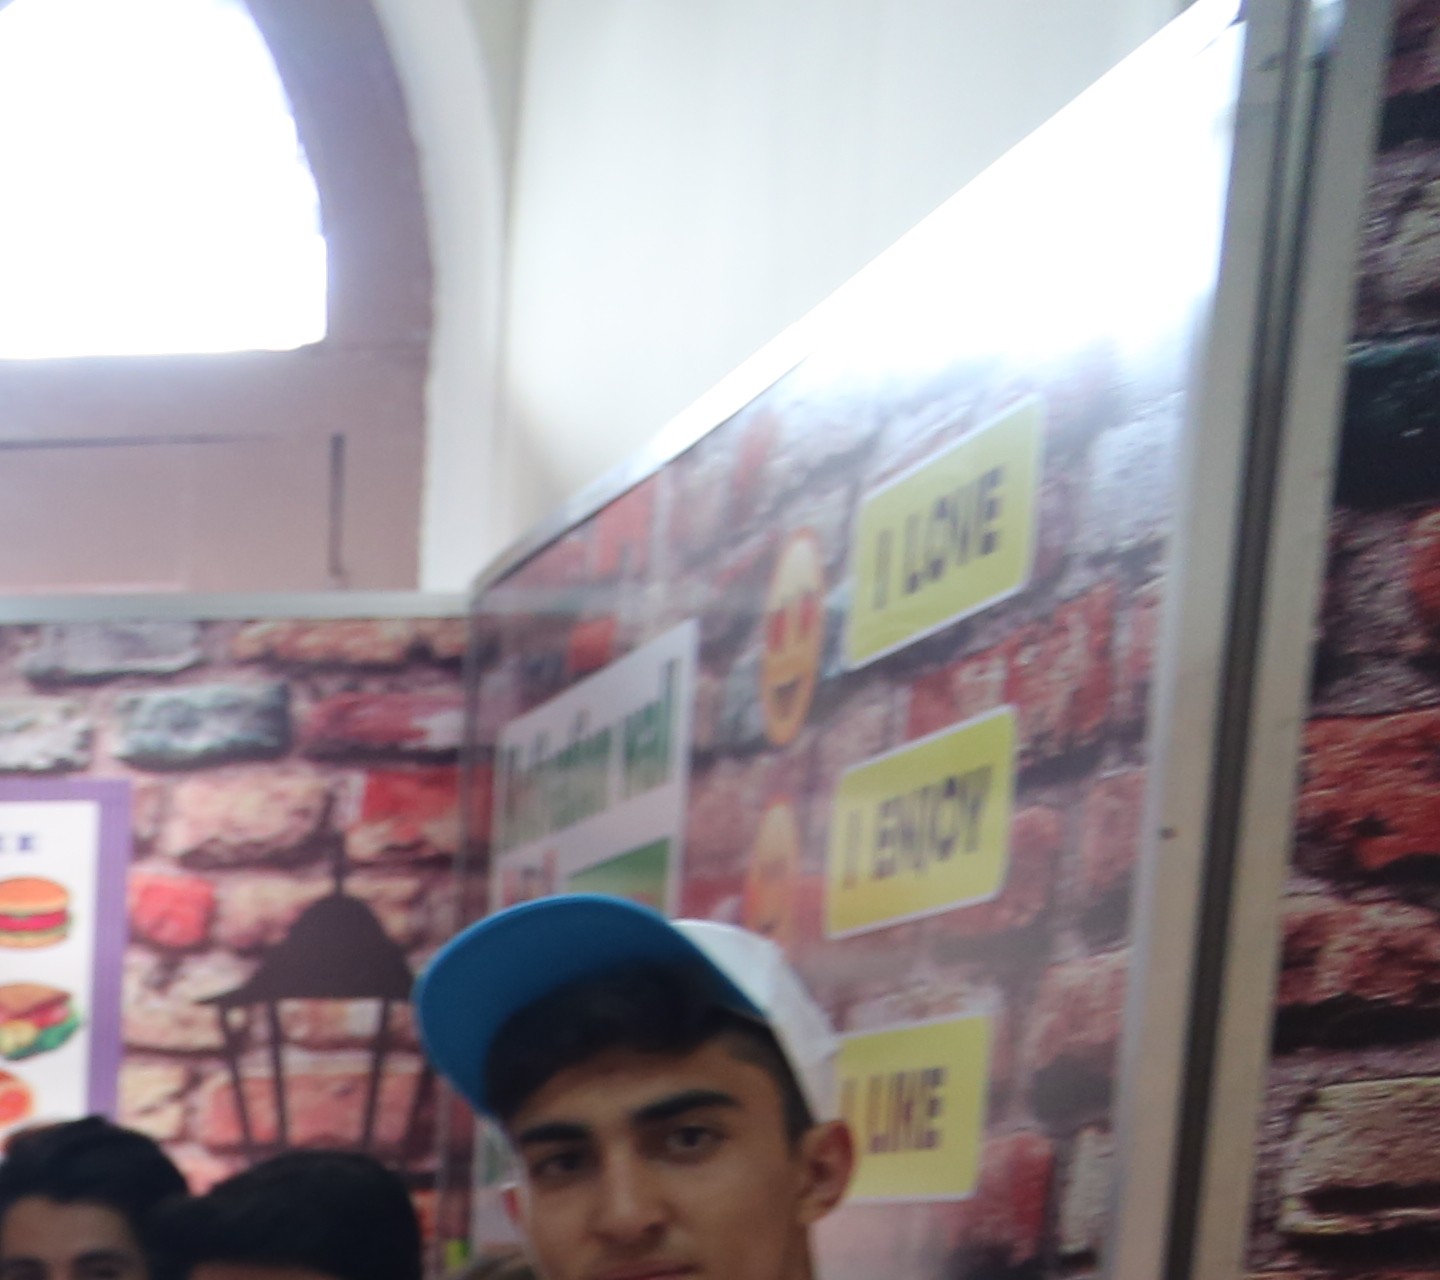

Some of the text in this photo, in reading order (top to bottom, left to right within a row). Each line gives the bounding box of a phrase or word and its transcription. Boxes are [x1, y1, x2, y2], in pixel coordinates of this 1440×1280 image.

[901, 463, 1005, 596] LOVE
[873, 763, 992, 879] ENJOY
[866, 1066, 946, 1155] LIKE
